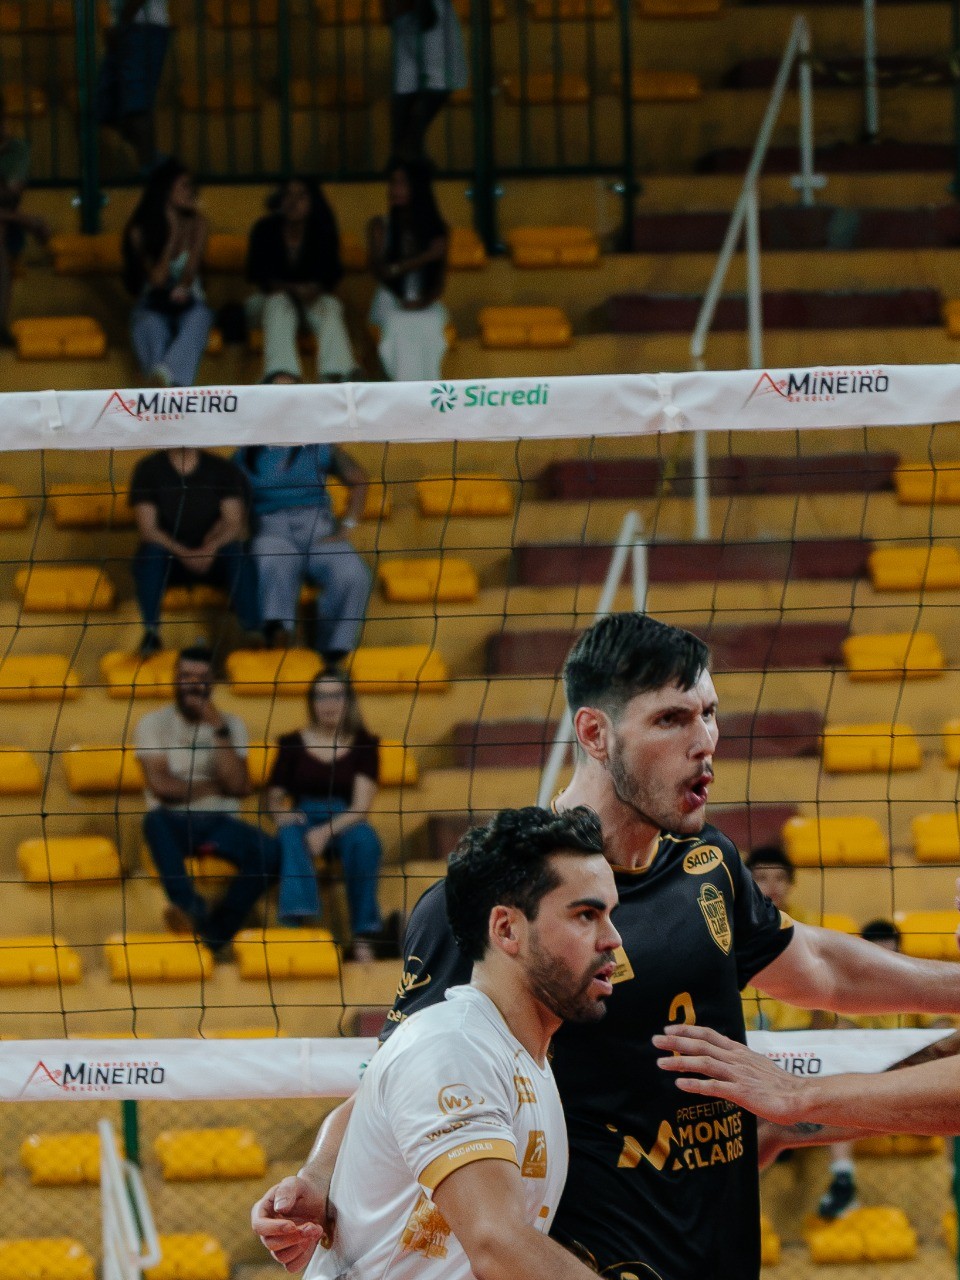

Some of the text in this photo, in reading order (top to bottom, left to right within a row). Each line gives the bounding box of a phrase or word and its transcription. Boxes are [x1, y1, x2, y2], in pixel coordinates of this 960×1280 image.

[787, 373, 889, 395] MINEIRO
[136, 392, 238, 414] MINEIRO
[464, 383, 550, 408] Sicredi
[687, 849, 719, 869] SADA
[62, 1063, 165, 1085] MINEIRO
[676, 1101, 739, 1123] PREFEITU
